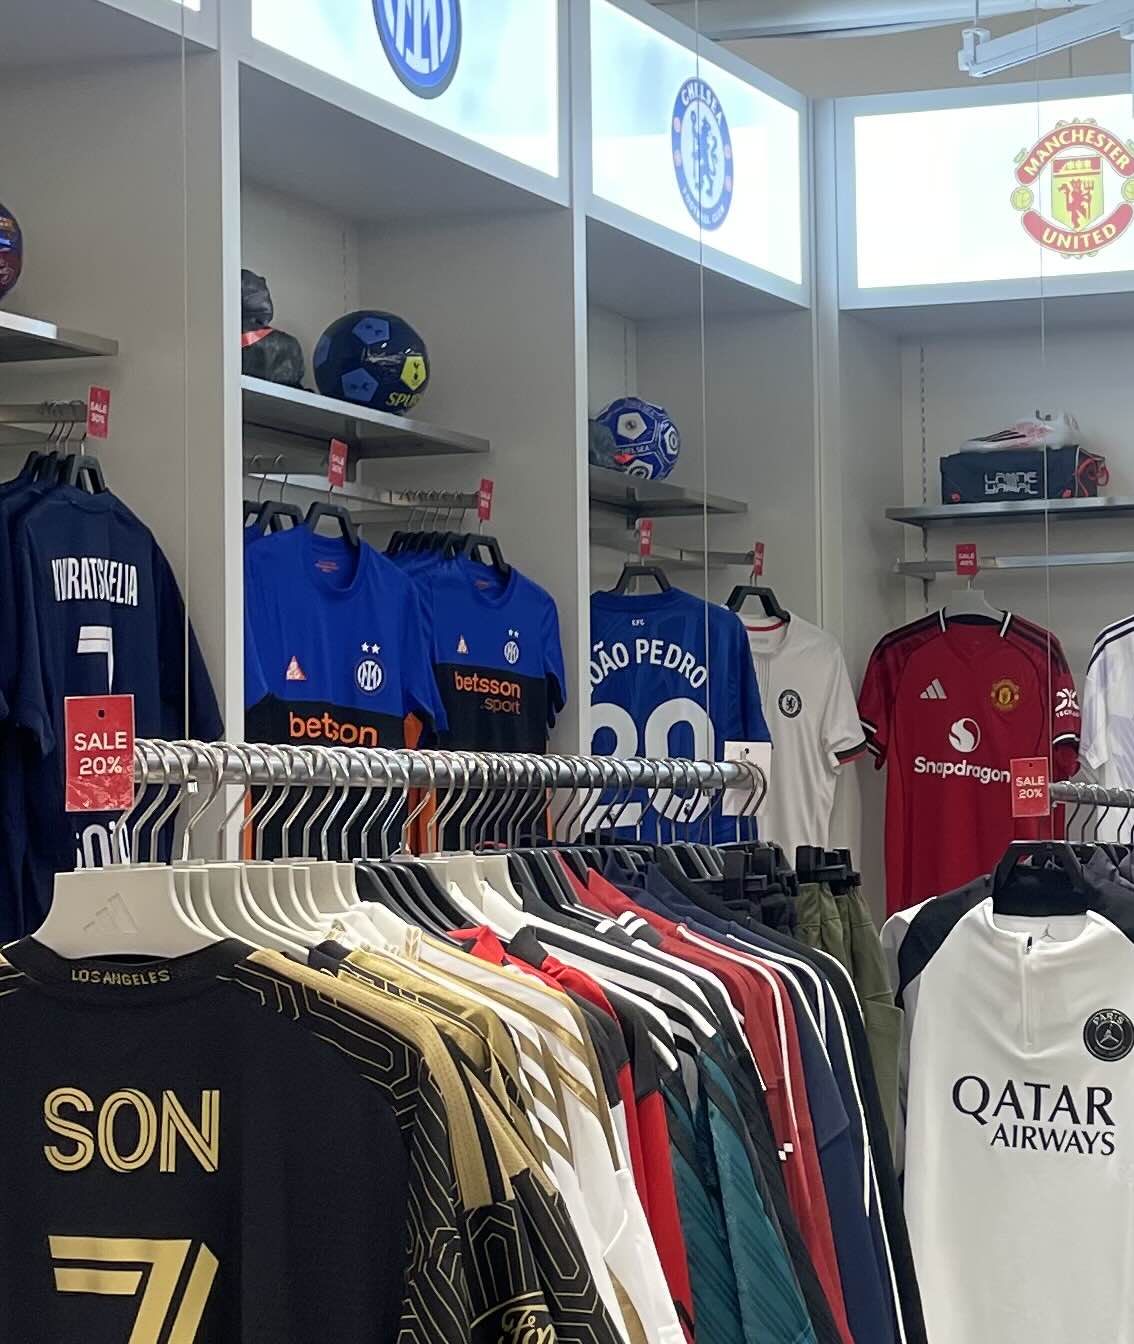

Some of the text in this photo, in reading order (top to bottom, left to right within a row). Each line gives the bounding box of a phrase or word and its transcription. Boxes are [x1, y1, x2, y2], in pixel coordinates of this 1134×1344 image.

[1023, 129, 1131, 176] MANCHESTER
[1042, 223, 1117, 249] UNITED
[590, 638, 708, 697] OÃO PEDRO
[454, 671, 521, 699] betsson
[74, 731, 128, 752] SALE
[79, 756, 123, 775] 20%
[913, 756, 1011, 784] Snapdragon
[1015, 776, 1045, 787] SALE
[1018, 788, 1043, 799] 20%
[71, 969, 171, 986] LOS ANGELES
[1092, 1012, 1125, 1026] PARIS
[952, 1075, 1116, 1126] QATAR
[43, 1085, 220, 1174] SON
[990, 1122, 1116, 1156] AIRWAYS
